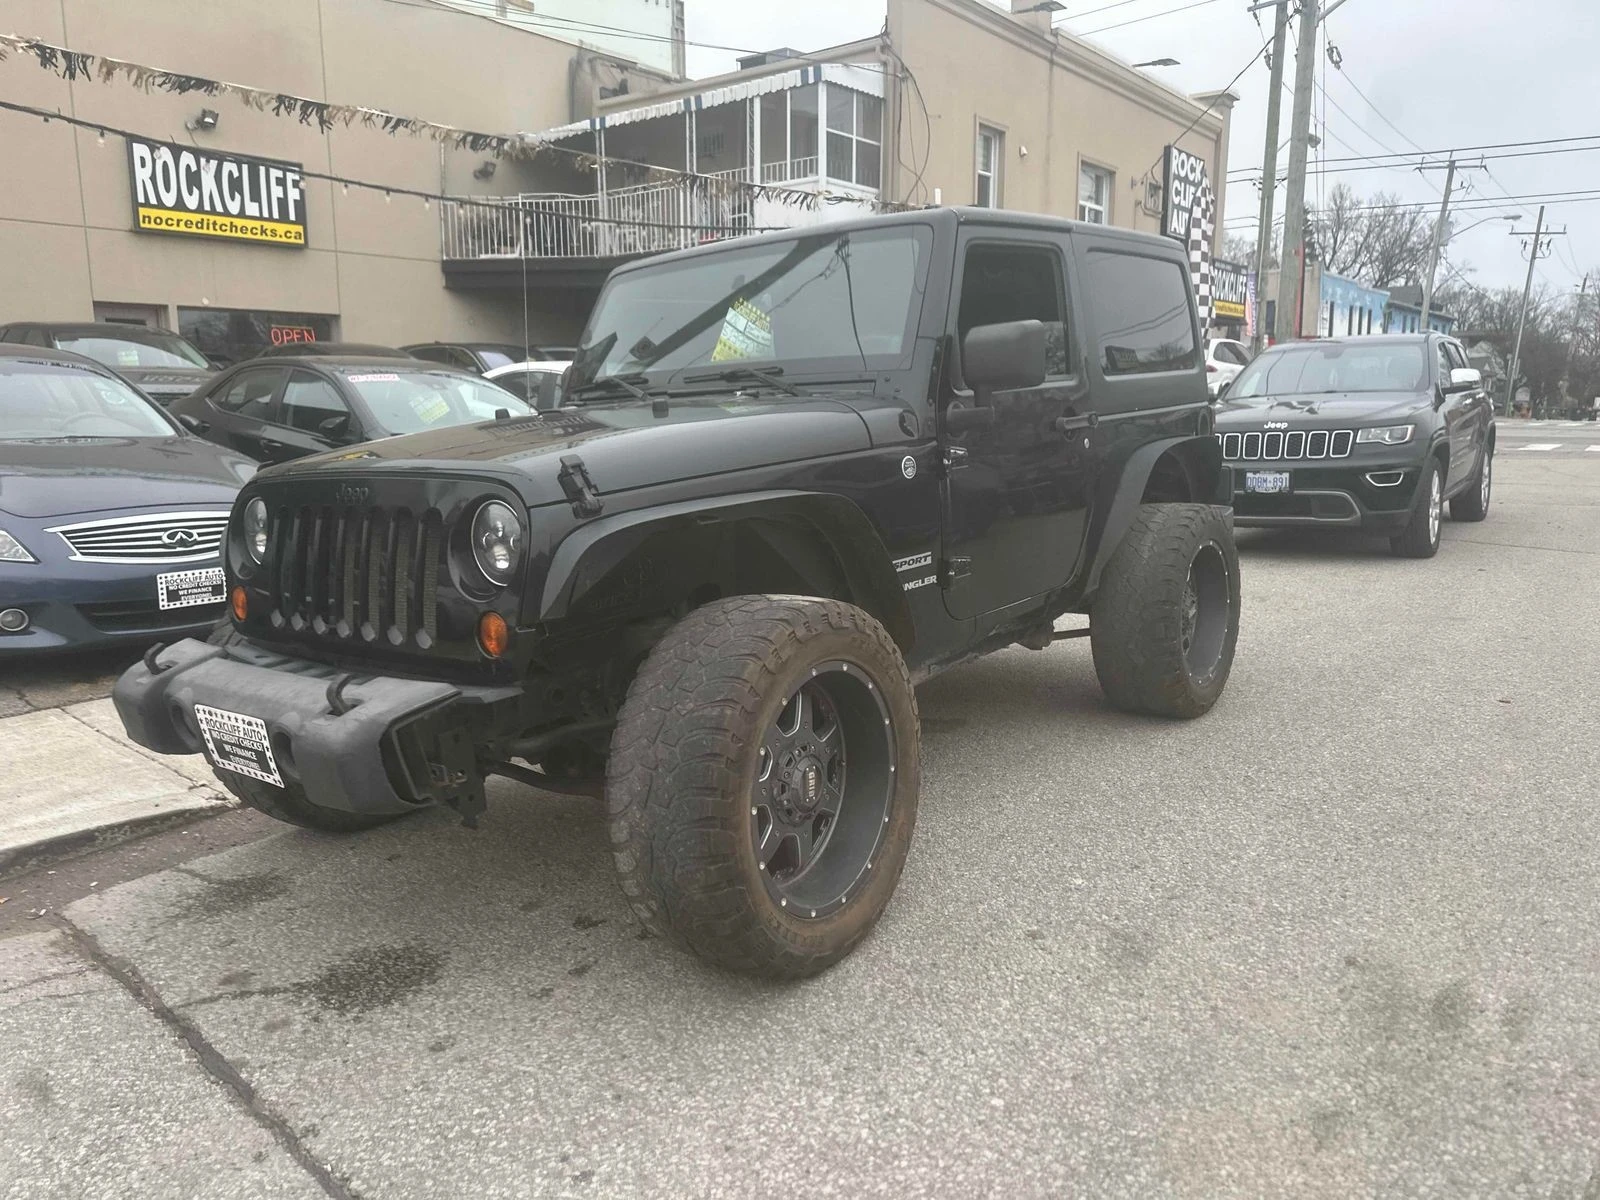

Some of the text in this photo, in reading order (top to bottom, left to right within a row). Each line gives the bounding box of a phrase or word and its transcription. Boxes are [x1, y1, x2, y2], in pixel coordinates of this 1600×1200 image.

[1172, 147, 1204, 184] ROCK
[132, 142, 301, 221] ROCKCLIFF
[1172, 179, 1195, 209] CLIF
[142, 213, 303, 241] nocreditchecks.ca
[1170, 208, 1189, 235] AU
[271, 328, 316, 346] OPEN
[1263, 421, 1288, 429] Jeep
[336, 483, 369, 502] Jeep
[164, 573, 223, 586] ROCKCLIFF AUTO
[188, 586, 213, 594] FINANCE
[902, 575, 938, 591] NGLER
[205, 717, 263, 742] ROCKCLIFF AUTO
[210, 730, 264, 752] NO CREDIT CHECKS!
[233, 747, 258, 760] FINANCE
[808, 771, 816, 797] GRID
